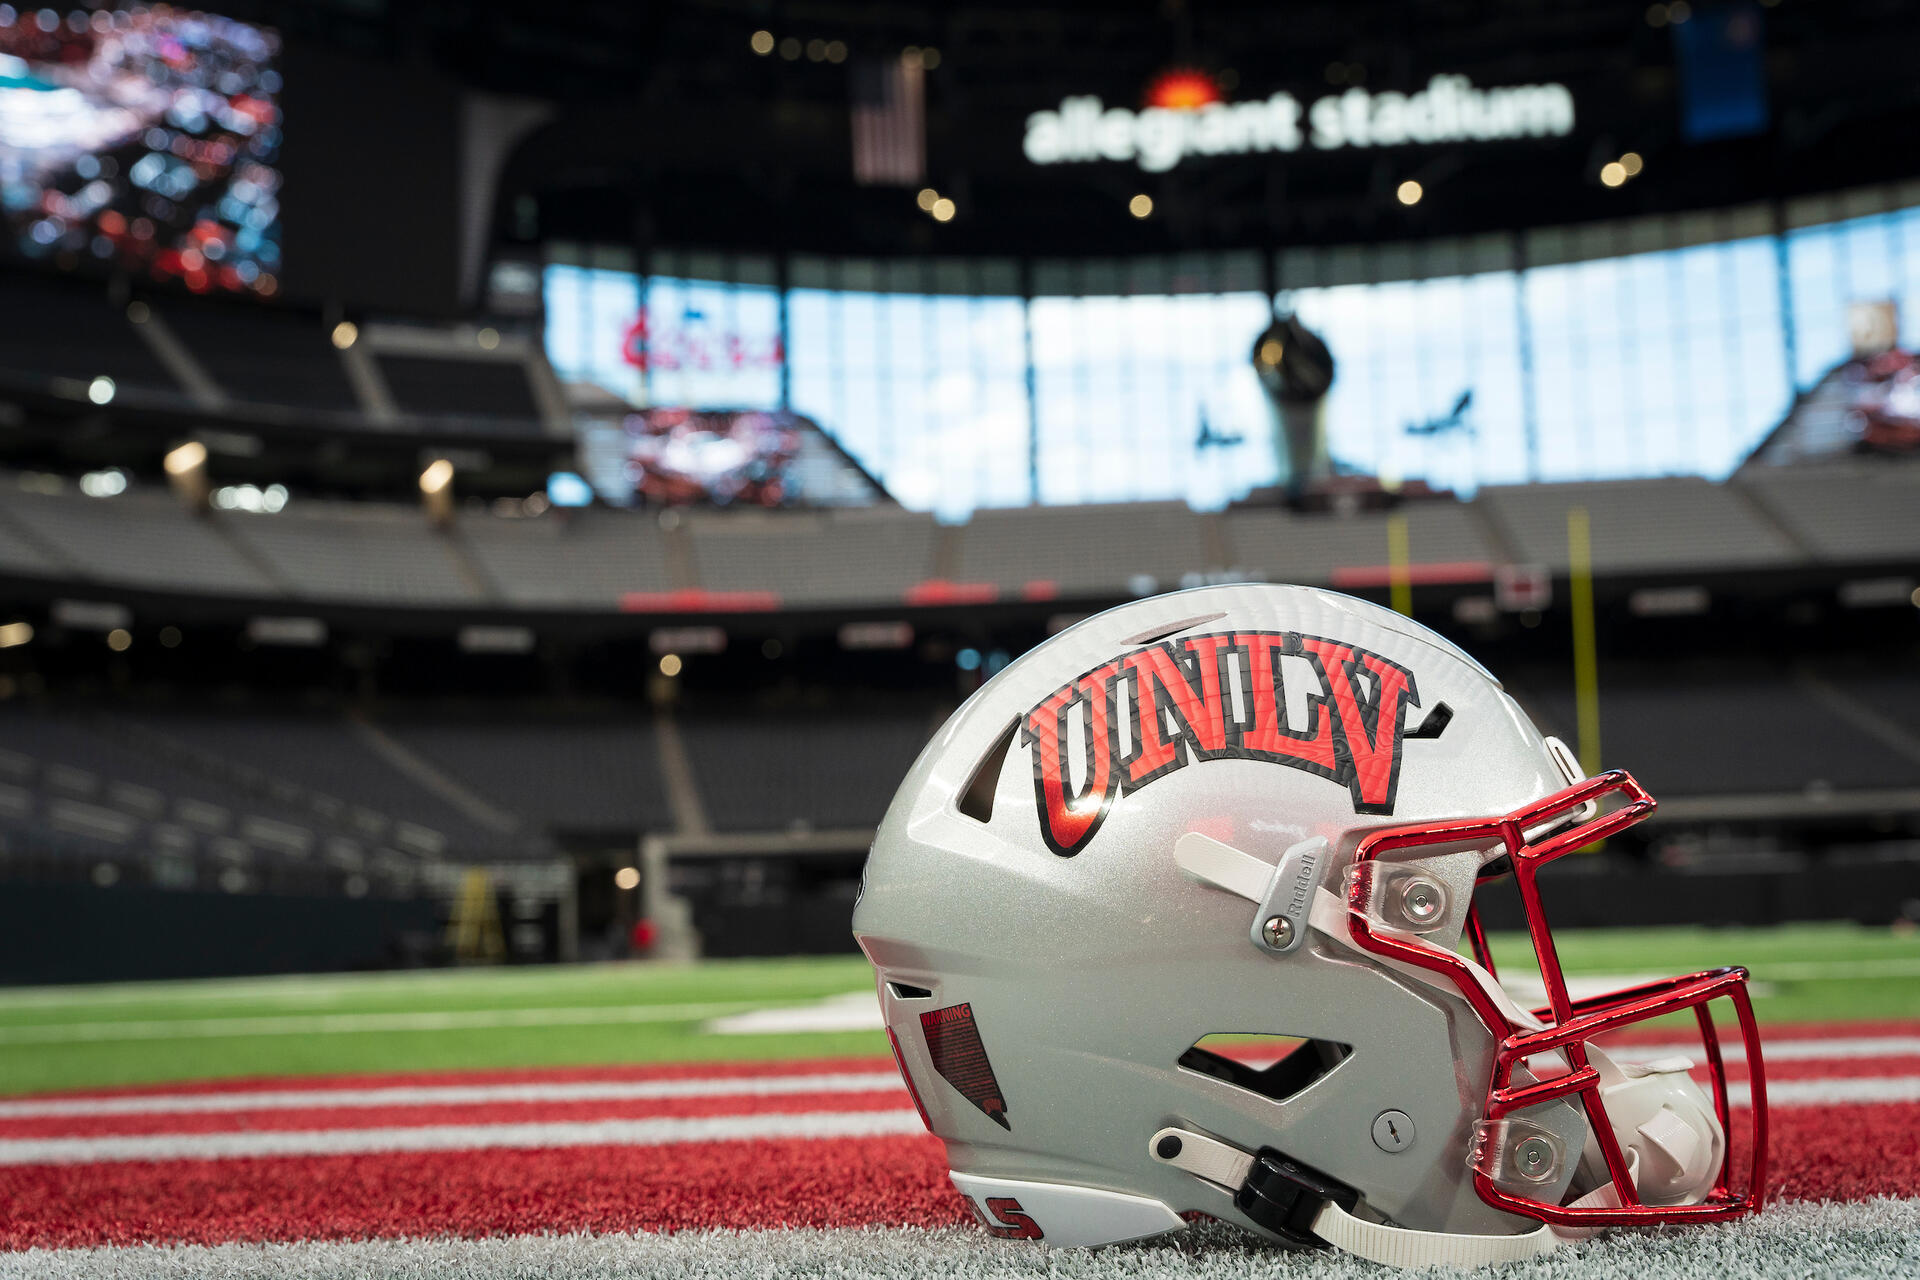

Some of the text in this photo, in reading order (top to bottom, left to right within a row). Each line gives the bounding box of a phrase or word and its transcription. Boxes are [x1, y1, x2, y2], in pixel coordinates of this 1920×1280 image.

[1024, 75, 1574, 171] allegiant stadium
[1022, 630, 1421, 857] UNLV
[1287, 854, 1317, 917] Riddell
[921, 1003, 971, 1027] WARNING
